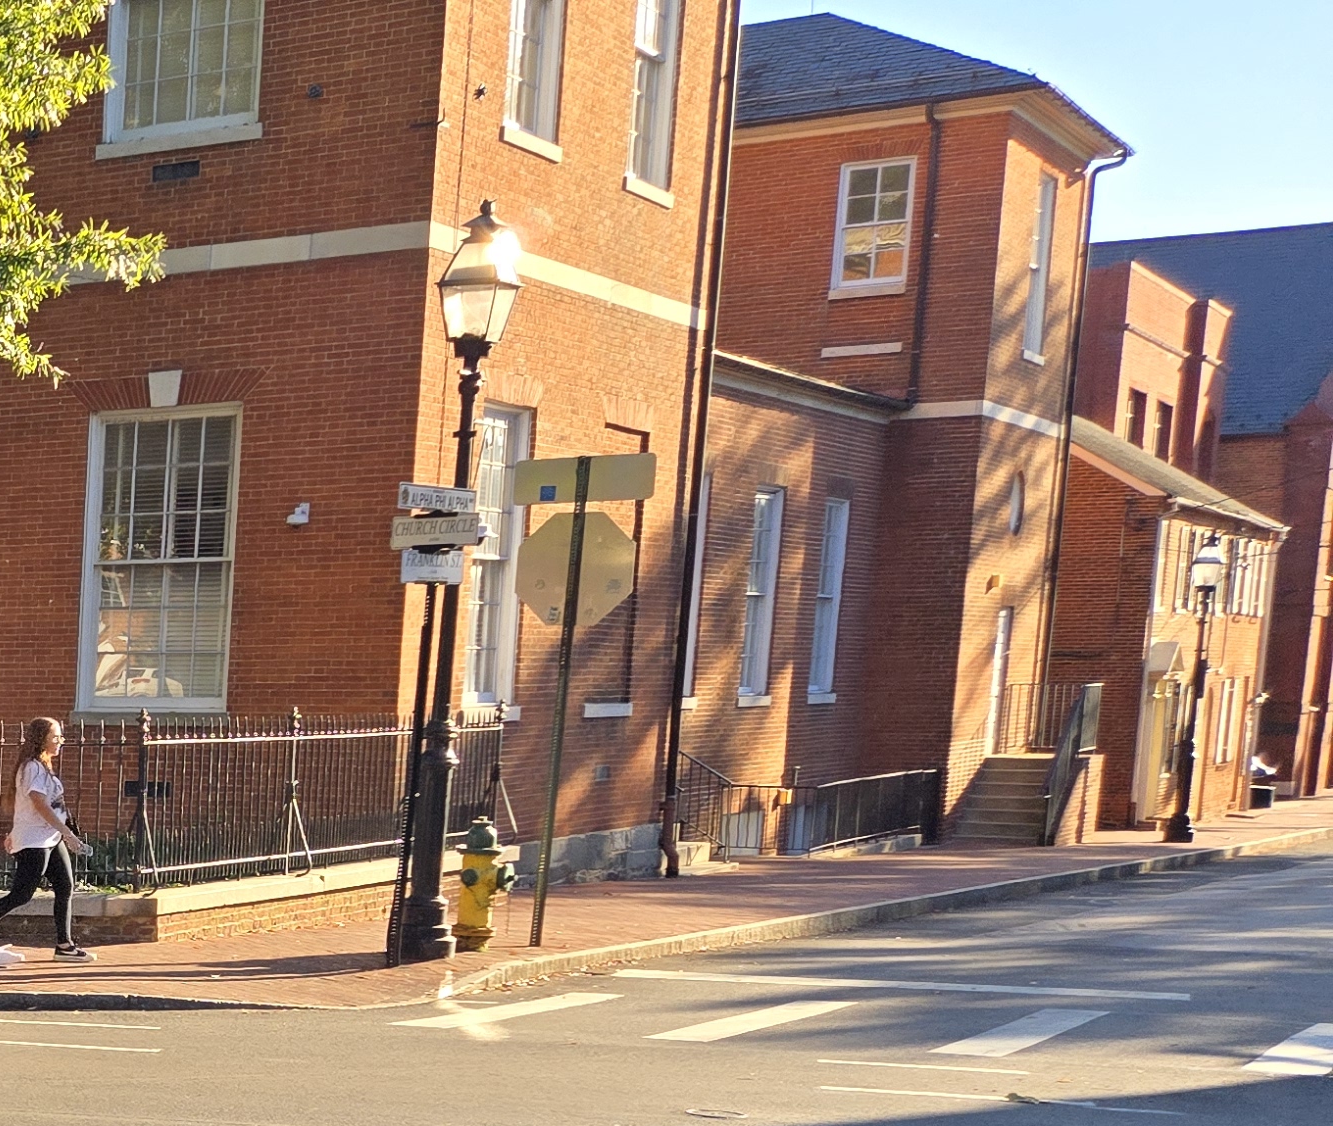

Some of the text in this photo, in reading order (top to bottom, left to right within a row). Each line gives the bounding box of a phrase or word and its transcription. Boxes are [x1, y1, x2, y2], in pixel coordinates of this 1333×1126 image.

[410, 491, 433, 507] ALPHA
[434, 494, 446, 508] PHI
[447, 496, 469, 510] ALPHA
[395, 518, 475, 536] CHURCH CIRCLE
[405, 553, 449, 568] FRANKLIN
